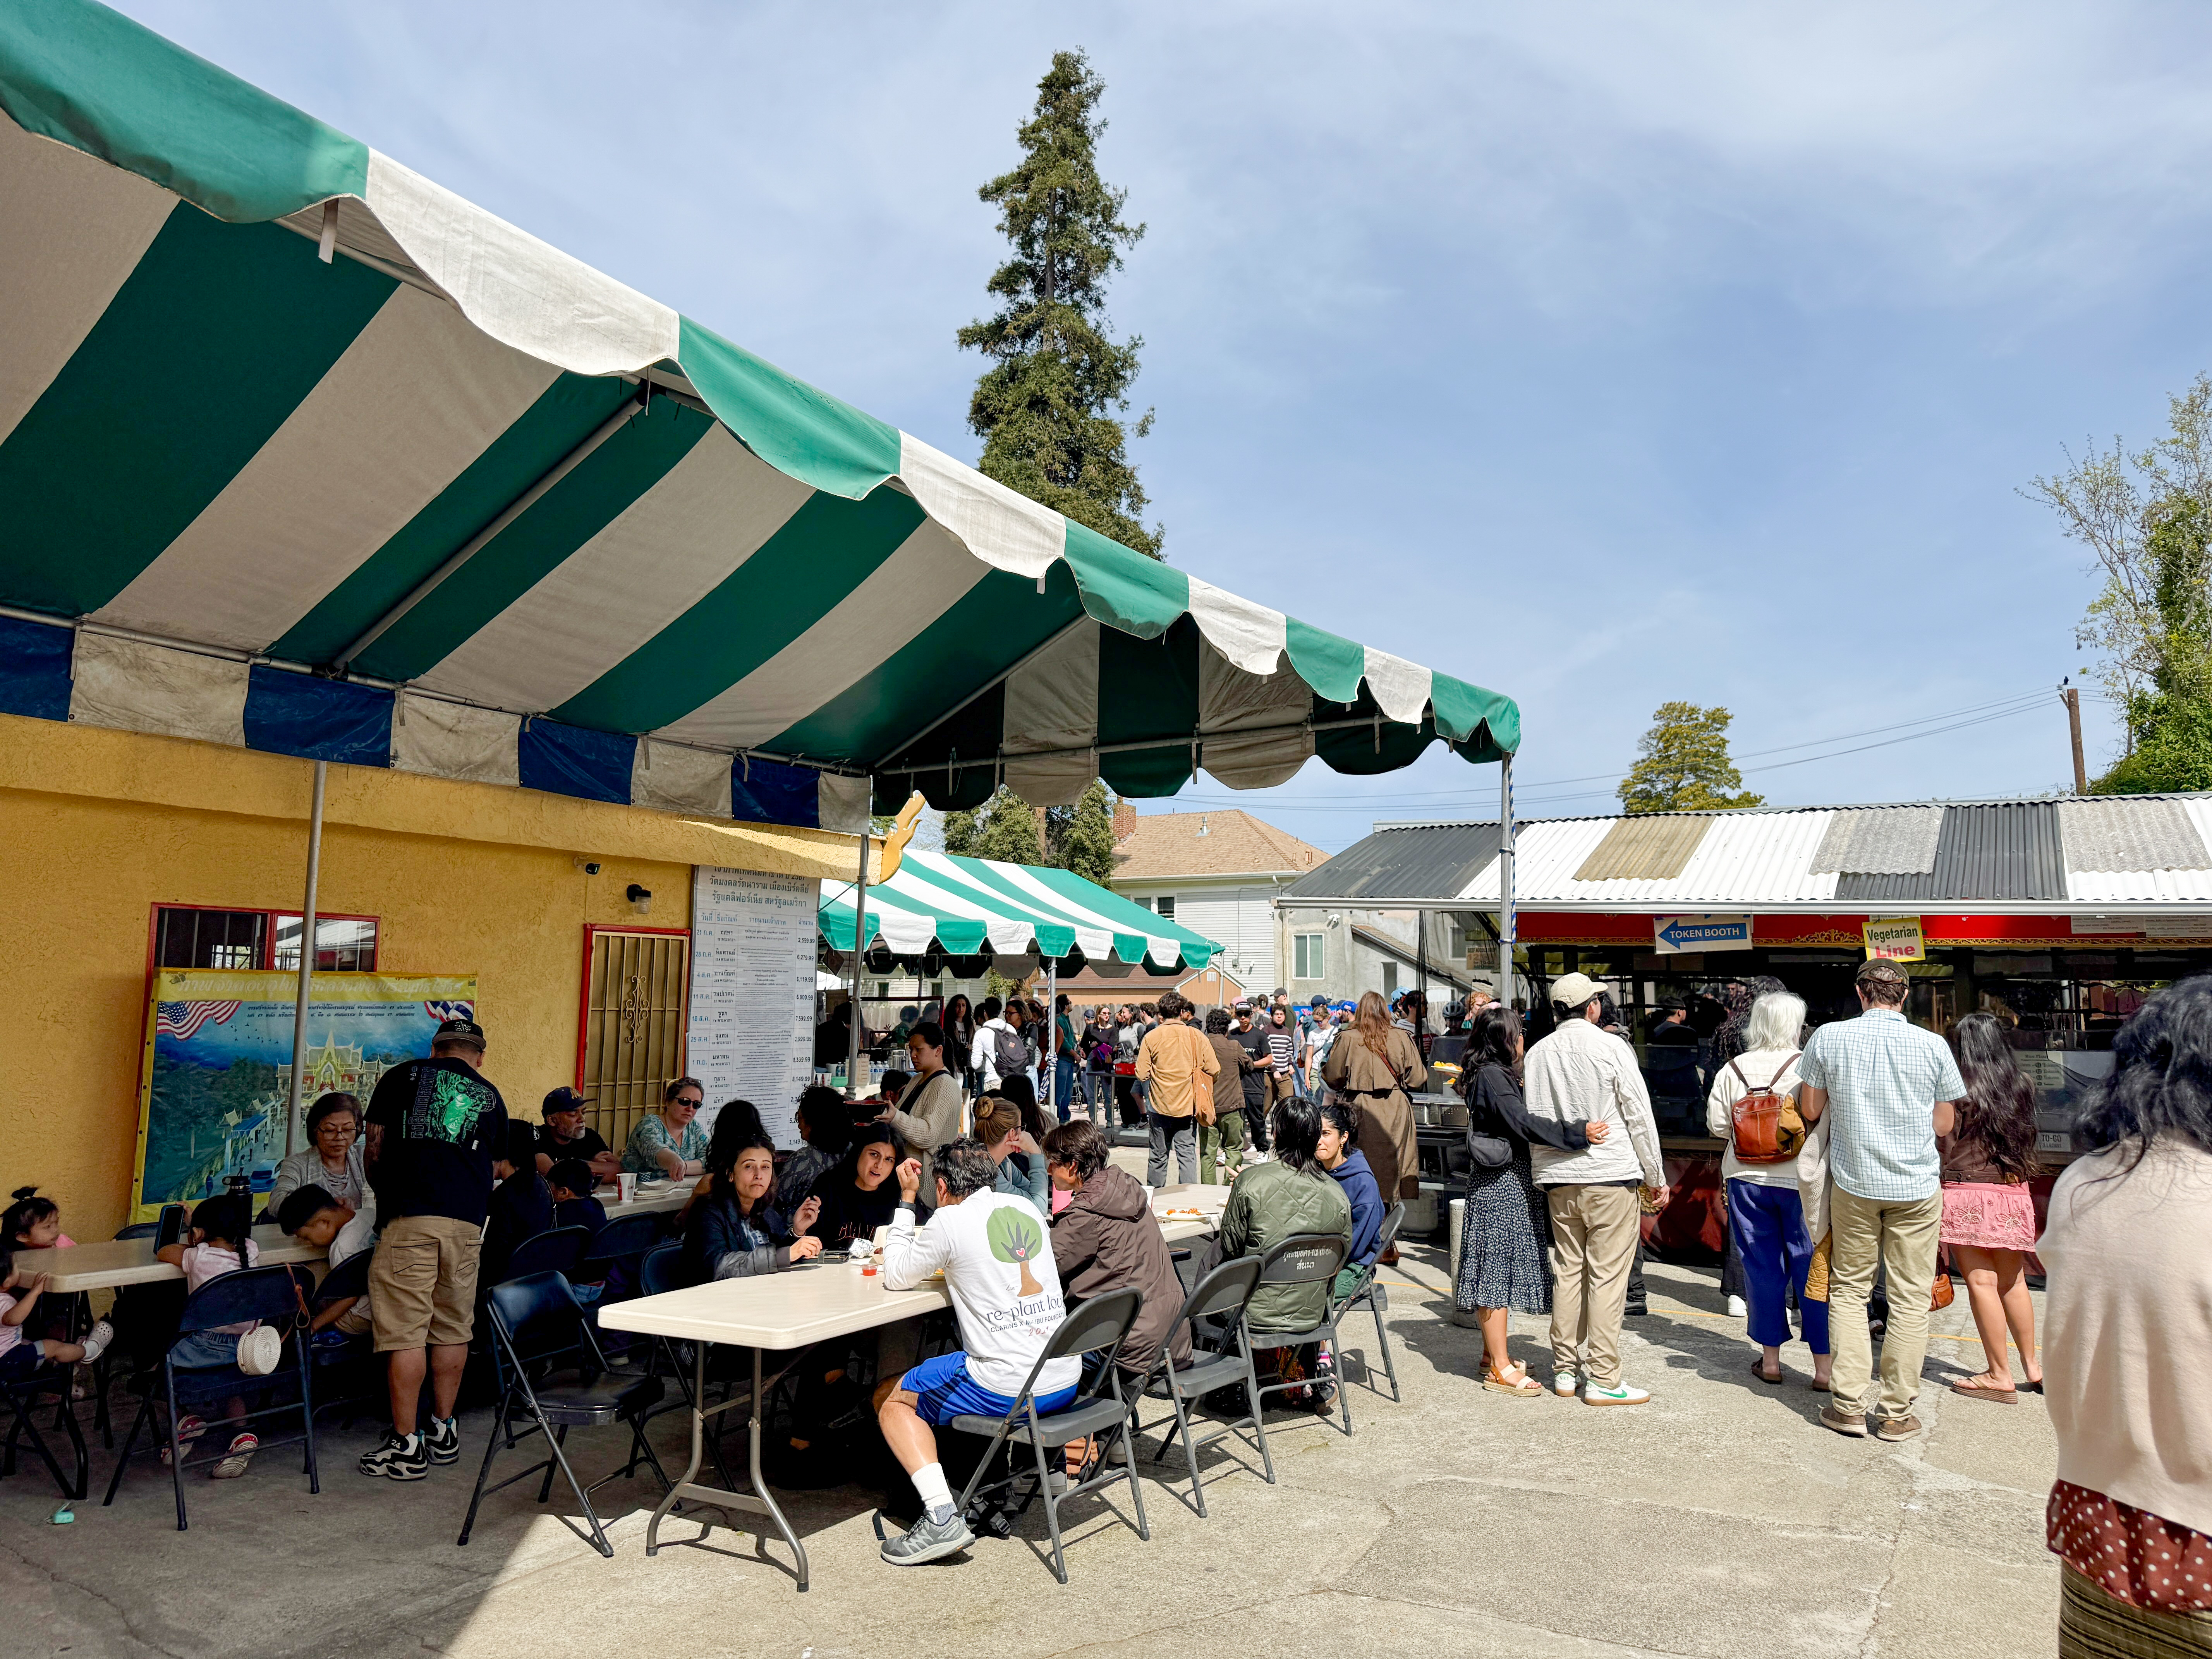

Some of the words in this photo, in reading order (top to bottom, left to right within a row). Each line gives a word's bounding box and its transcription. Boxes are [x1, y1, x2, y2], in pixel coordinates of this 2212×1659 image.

[709, 875, 768, 890] วัดมงคลรัตนาราม
[712, 890, 763, 904] รัฐแคลิฟอร์เนีย
[765, 895, 807, 908] สหรัฐอเมริกา
[701, 911, 713, 921] วันที่
[749, 916, 786, 926] รายนามเจ้าภาพ
[1669, 929, 1702, 939] TOKEN
[1704, 927, 1740, 937] BOOTH
[1867, 926, 1918, 943] Vegetarian
[1875, 945, 1915, 959] Line
[986, 1299, 1046, 1323] re-plant
[991, 1322, 1018, 1332] CLARINS
[1026, 1317, 1043, 1326] MIBU
[391, 1439, 401, 1449] 24
[942, 1524, 958, 1537] MERRELL
